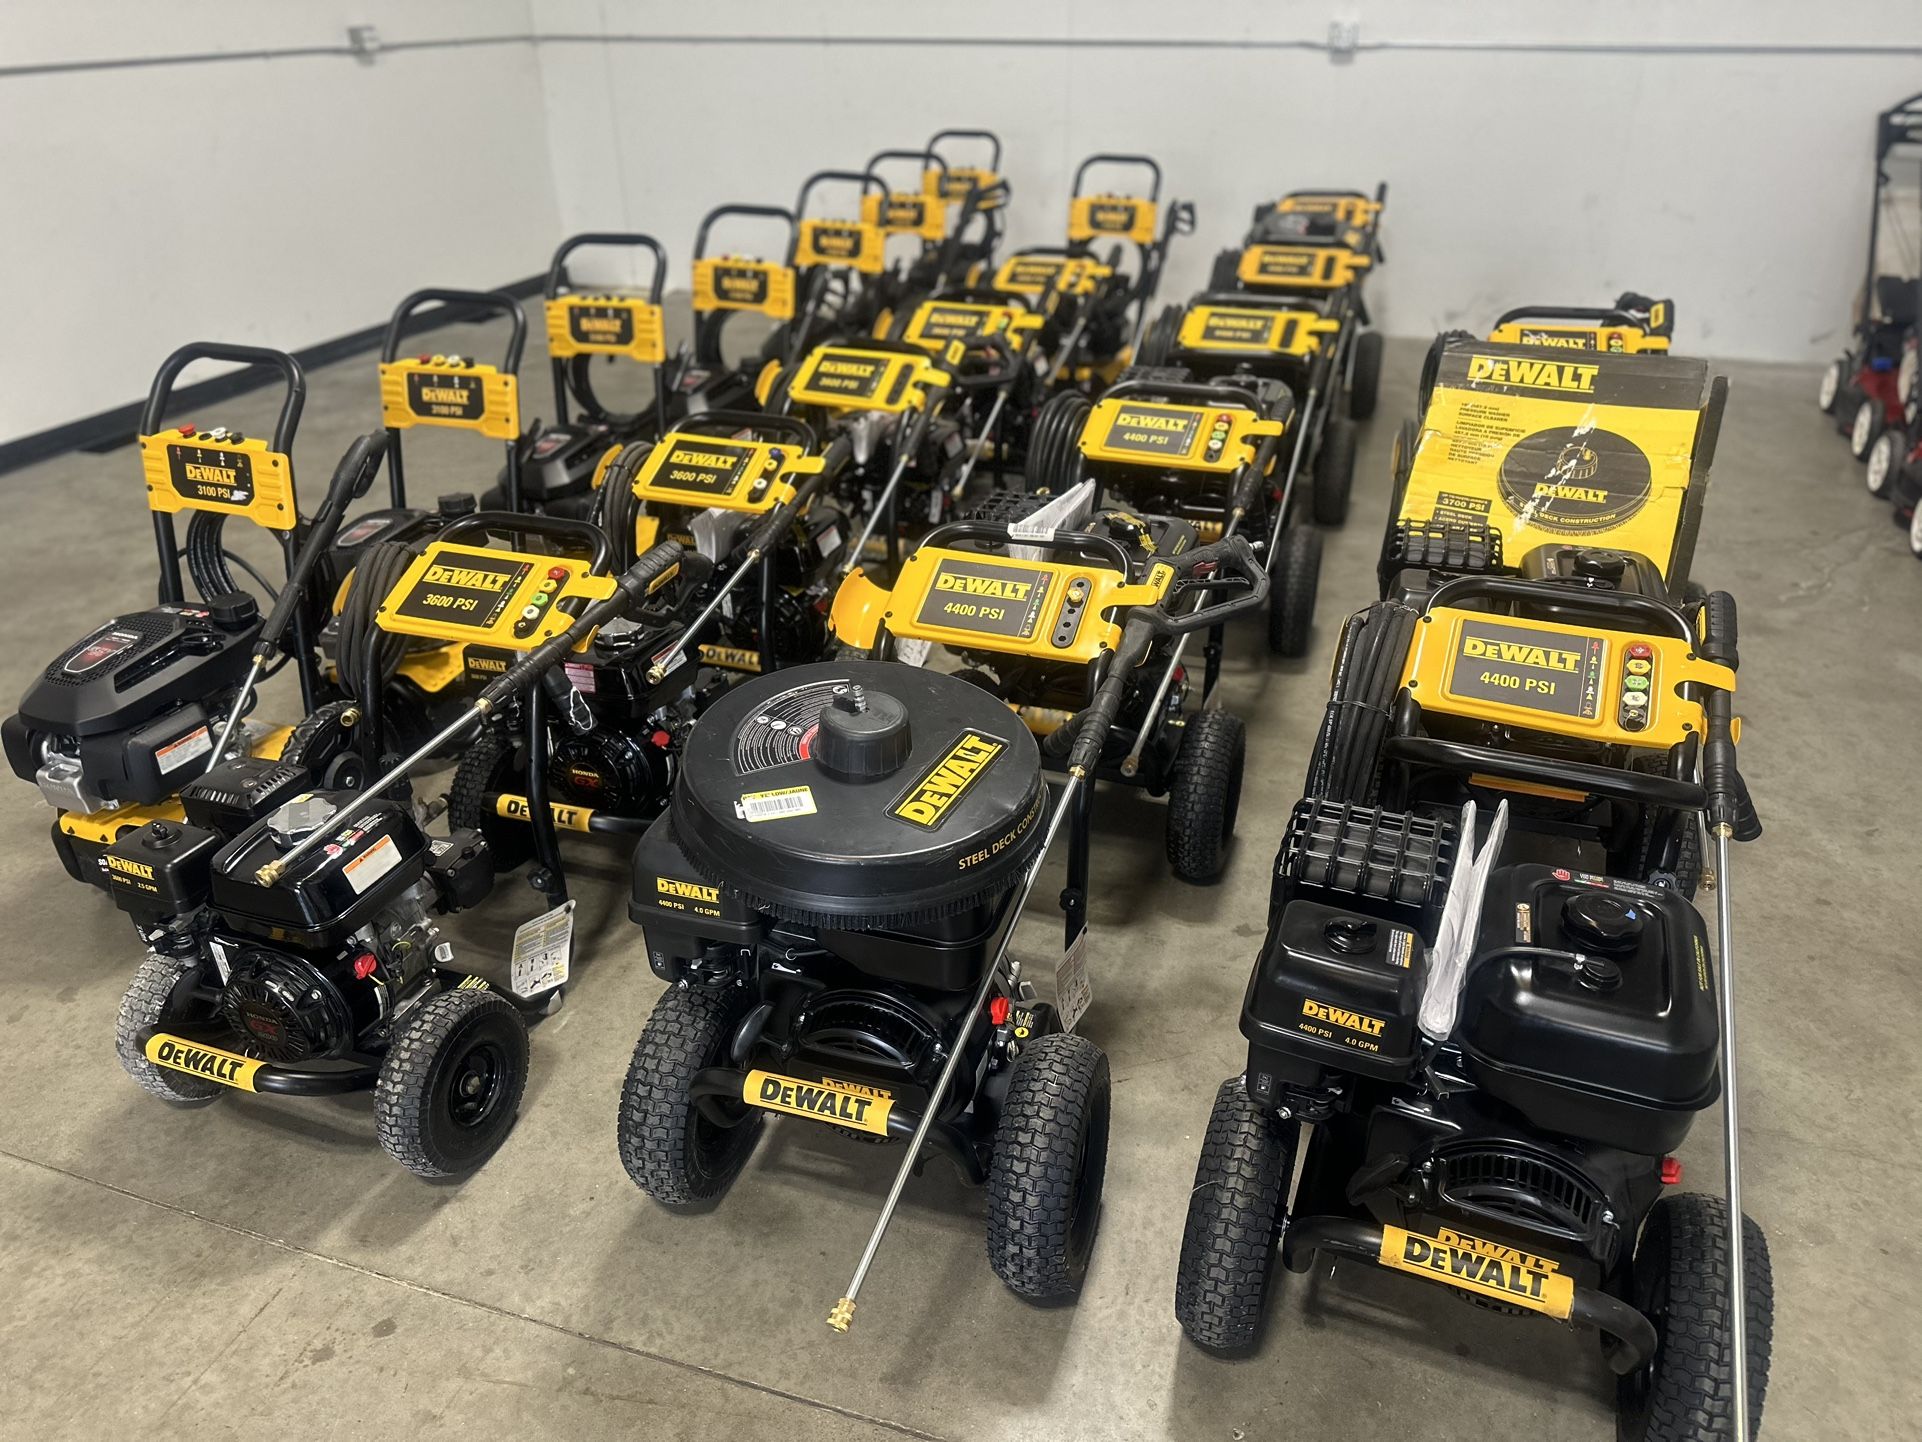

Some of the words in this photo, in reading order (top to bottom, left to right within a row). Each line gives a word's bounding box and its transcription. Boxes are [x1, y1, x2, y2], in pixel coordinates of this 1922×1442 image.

[1468, 356, 1600, 392] DEWALT
[1116, 412, 1188, 432] DEWALT
[1123, 432, 1148, 443] 4400
[1149, 434, 1169, 445] PSI
[670, 449, 737, 470] DEWALT
[186, 465, 237, 484] DEWALT
[670, 470, 696, 481] 3600
[697, 473, 717, 484] PSI
[197, 484, 216, 497] 3100
[217, 487, 231, 499] PSI
[1442, 498, 1467, 508] 3700
[1469, 502, 1485, 511] PSI
[425, 565, 512, 592] DEWALT
[935, 573, 1032, 600] DEWALT
[422, 594, 454, 608] 3600
[454, 597, 479, 612] PSI
[943, 602, 976, 617] 4400
[979, 606, 1006, 621] PSI
[468, 657, 507, 672] DEWALT
[1463, 638, 1582, 673] DEWALT
[1480, 671, 1521, 690] 4400
[1524, 677, 1557, 695] PSI
[571, 769, 600, 778] HONDA
[898, 734, 1001, 825] DEWALT
[958, 848, 990, 870] STEEL
[991, 829, 1017, 855] DECK
[107, 855, 154, 880] DEWALT
[657, 878, 720, 903] DEWALT
[658, 899, 672, 908] 4400
[673, 902, 685, 910] PSI
[694, 906, 704, 914] 4.0
[704, 908, 721, 917] GPM
[1302, 999, 1386, 1036] DEWALT
[1298, 1022, 1317, 1035] 4400
[1318, 1028, 1333, 1039] PSI
[1344, 1036, 1357, 1046] 4.0
[1358, 1040, 1379, 1052] GPM
[157, 1041, 245, 1081] DEWALT
[759, 1077, 872, 1123] DEWALT
[1402, 1235, 1549, 1298] DEWALT
